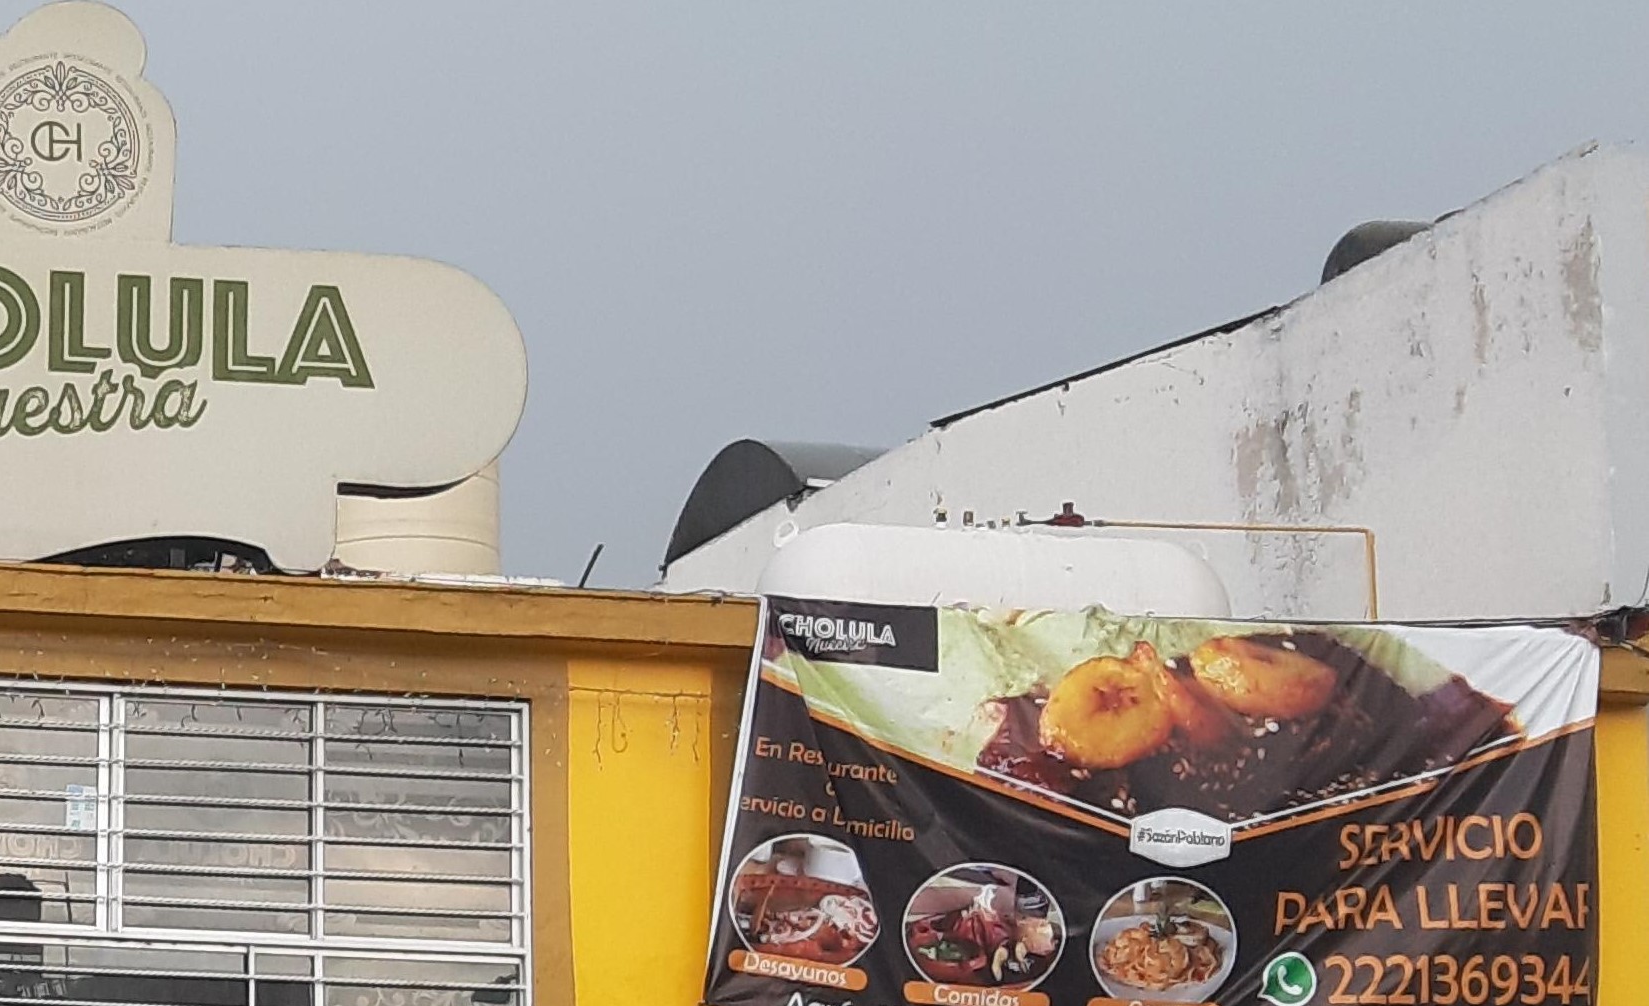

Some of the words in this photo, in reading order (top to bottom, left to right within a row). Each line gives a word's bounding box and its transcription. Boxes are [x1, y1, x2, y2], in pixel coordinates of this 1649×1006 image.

[778, 613, 897, 647] CHOLULA
[755, 737, 783, 760] En
[789, 742, 898, 784] Resurante
[740, 796, 806, 820] ervicio
[811, 808, 826, 822] a
[1339, 812, 1544, 870] SERVICIO
[1274, 884, 1402, 936] PARA
[743, 954, 847, 987] Desayunos
[1325, 954, 1591, 1006] 2221369344
